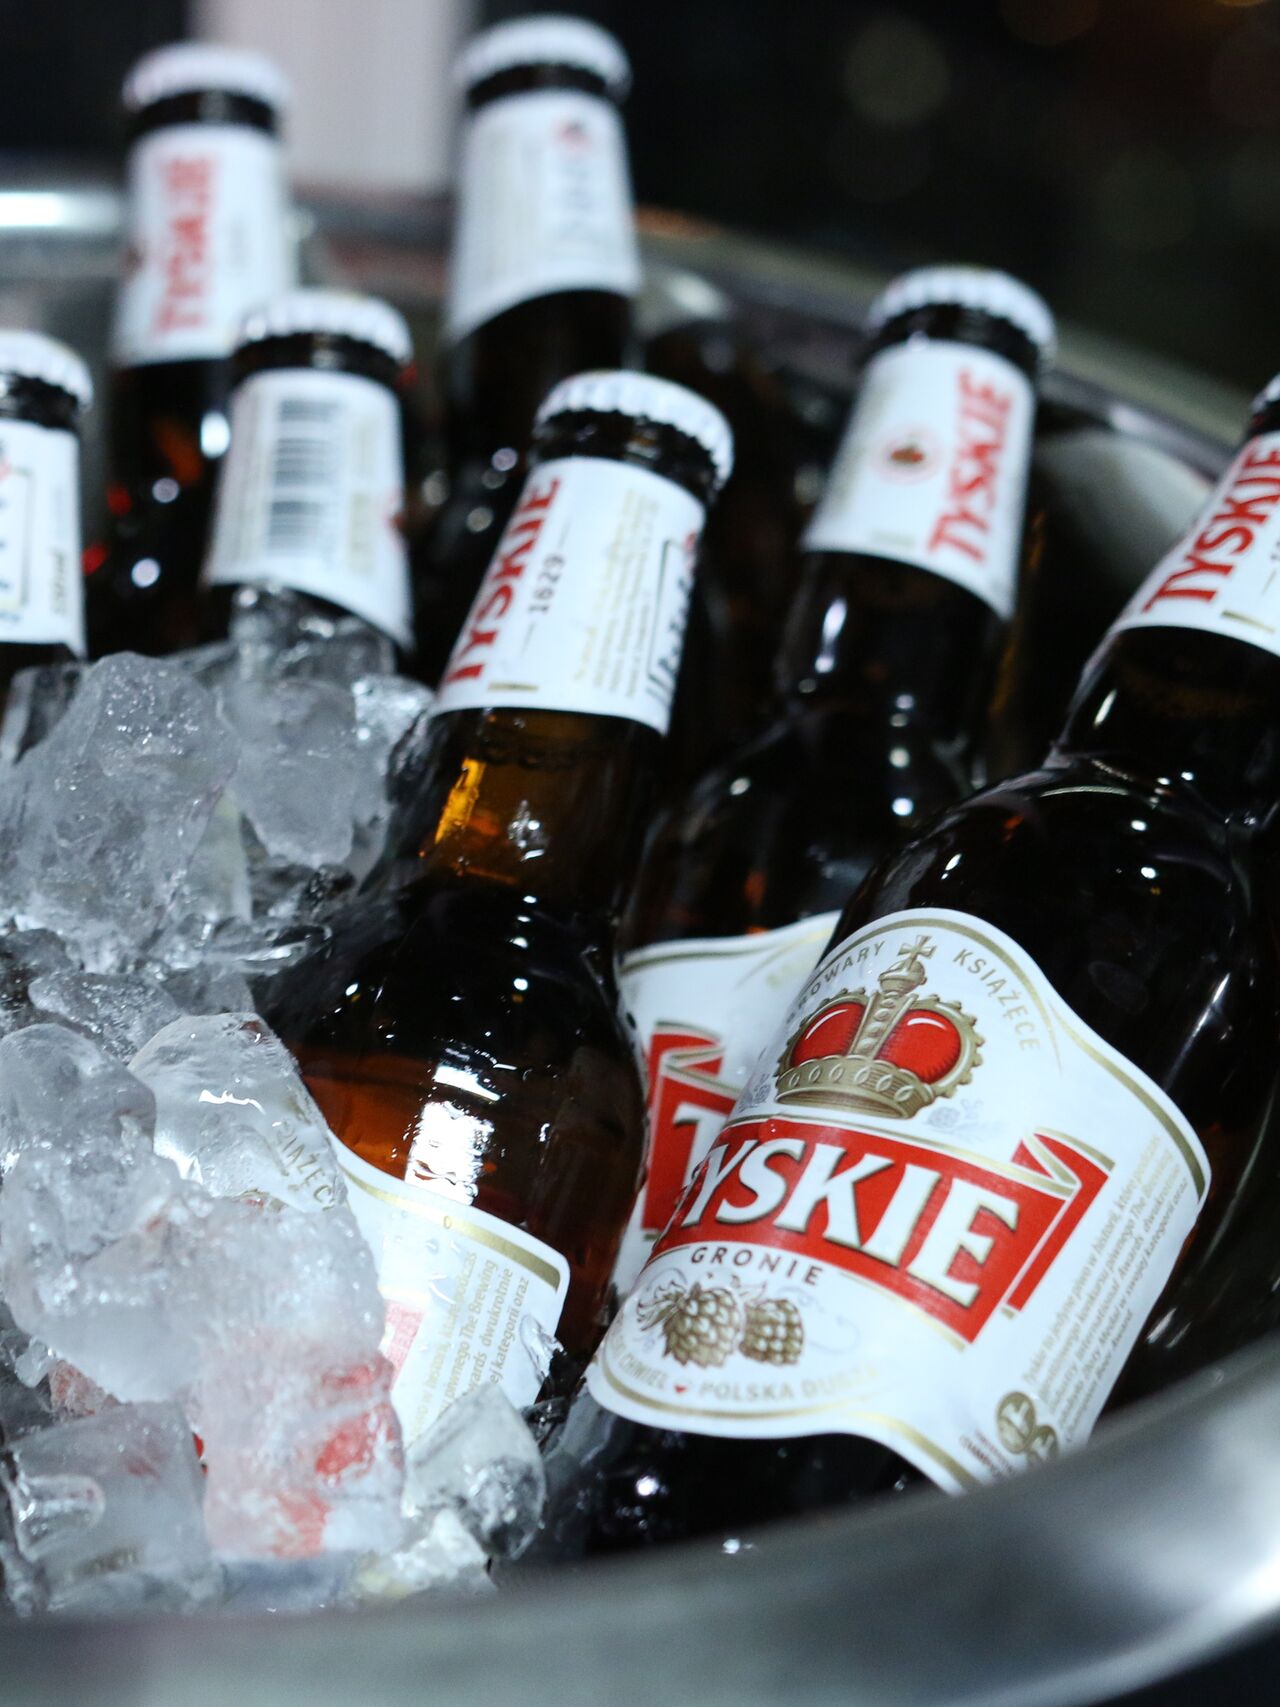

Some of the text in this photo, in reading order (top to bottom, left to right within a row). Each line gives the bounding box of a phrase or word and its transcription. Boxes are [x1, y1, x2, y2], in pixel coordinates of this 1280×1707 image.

[928, 368, 1012, 563] TYSKIE
[529, 554, 565, 614] 1629
[952, 948, 1041, 1053] KSIĄŻĘCE
[680, 1138, 1019, 1309] YSKIE
[468, 1258, 498, 1315] Brewing
[690, 1246, 824, 1286] GRONIE
[459, 1315, 478, 1339] The
[478, 1266, 513, 1348] dwukrotnie
[491, 1305, 523, 1370] kategorii
[512, 1276, 529, 1306] oraz
[699, 1378, 795, 1401] POLSKA
